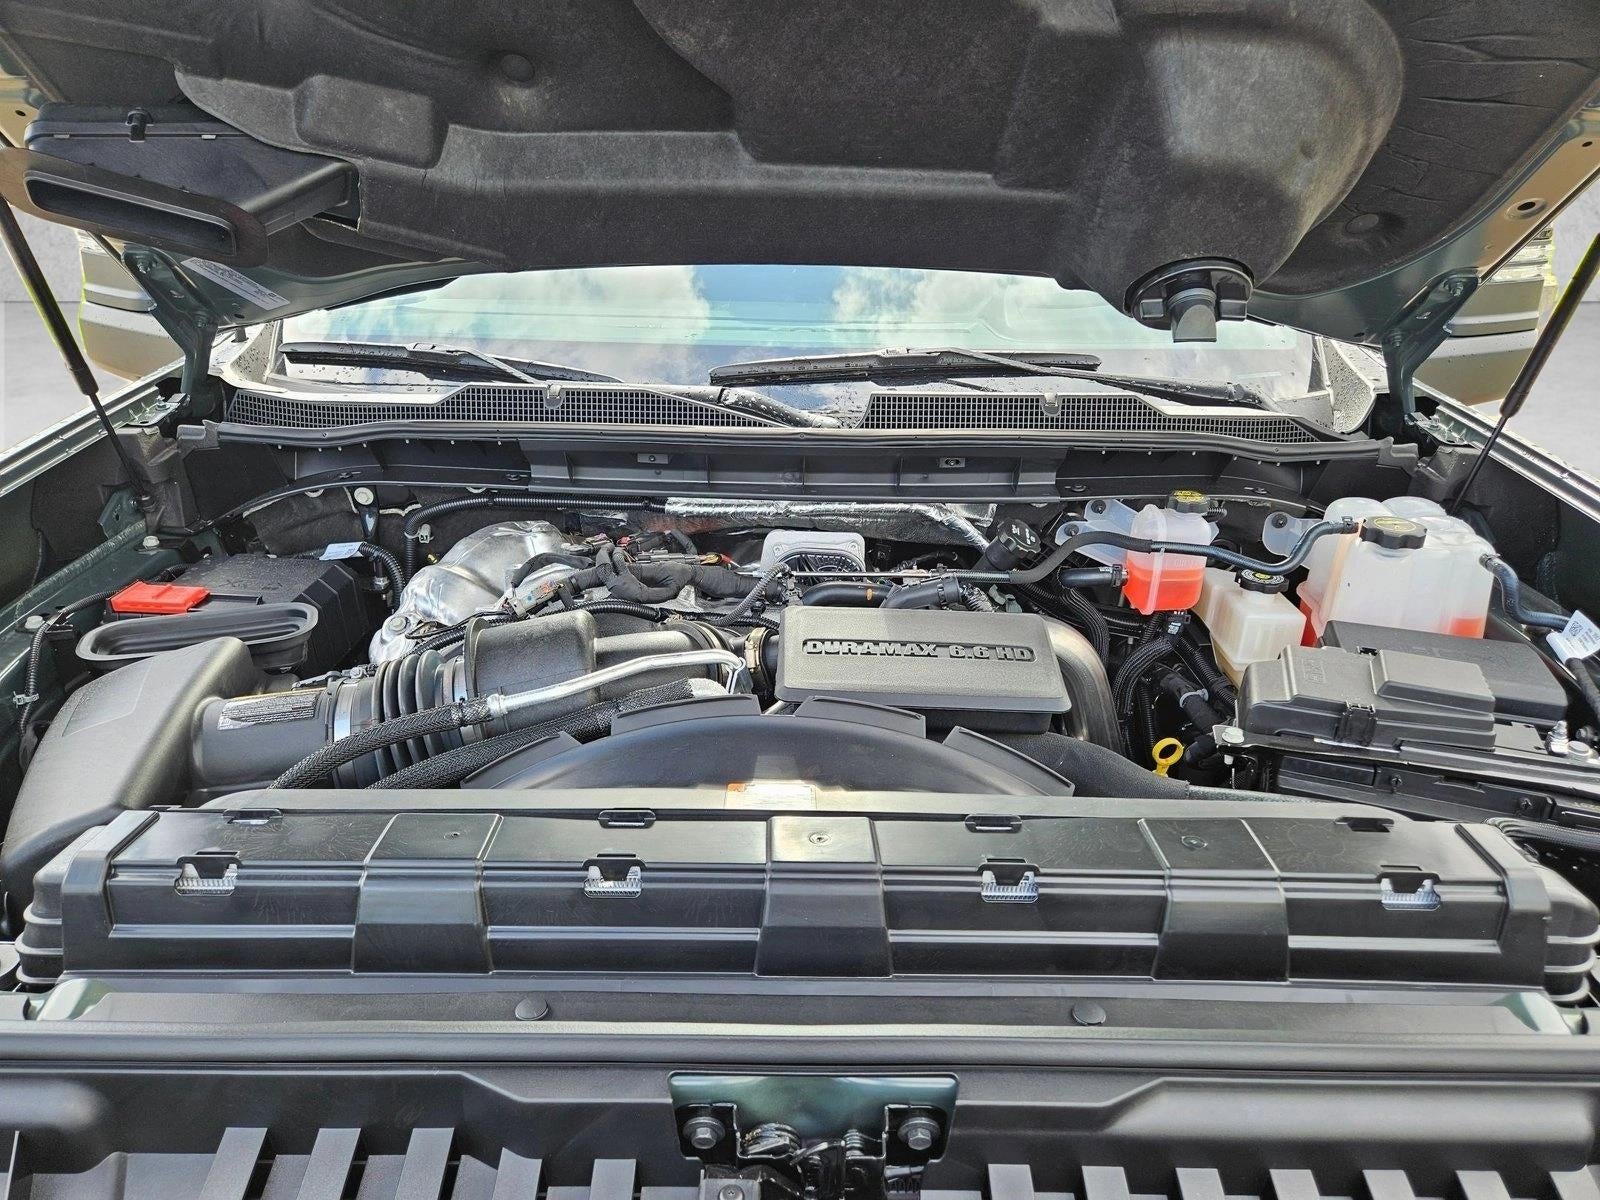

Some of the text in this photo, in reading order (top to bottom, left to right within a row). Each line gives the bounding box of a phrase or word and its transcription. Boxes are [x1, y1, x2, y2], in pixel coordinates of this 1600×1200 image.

[805, 640, 1032, 661] DURAMAX 6.6 HD
